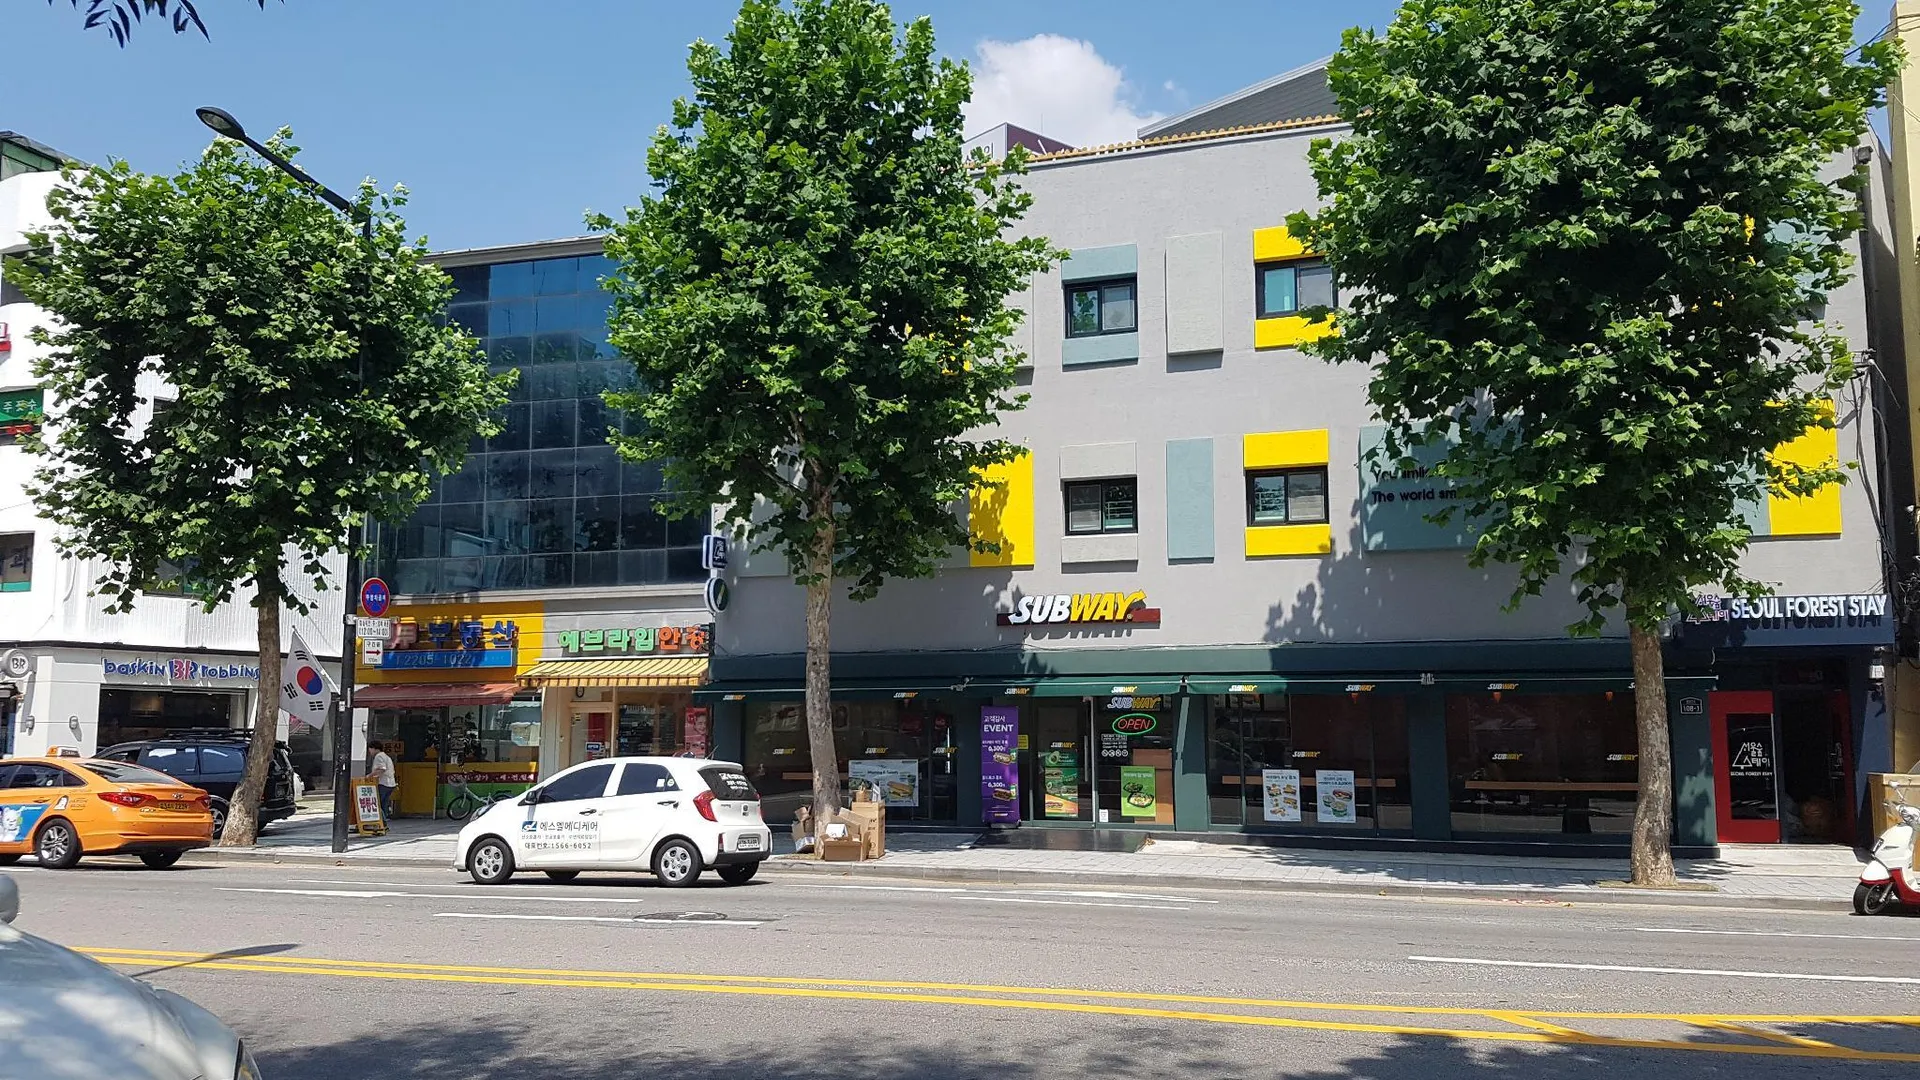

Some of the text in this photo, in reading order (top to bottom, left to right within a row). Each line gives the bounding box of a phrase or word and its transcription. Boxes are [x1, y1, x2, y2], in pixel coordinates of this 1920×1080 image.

[1372, 491, 1395, 504] The
[1400, 488, 1435, 501] world
[1008, 589, 1147, 625] SUBWAY
[1731, 594, 1887, 619] SEOUL FOREST STAY
[12, 657, 27, 670] BR
[102, 657, 166, 677] baskin
[200, 663, 261, 680] robbins
[1111, 686, 1138, 694] SUBWAY
[1228, 684, 1258, 692] SUBWAY
[1345, 684, 1376, 692] SUBWAY
[1107, 697, 1161, 709] SUBWAY
[983, 724, 1014, 732] EVENT
[1117, 718, 1151, 730] OPEN
